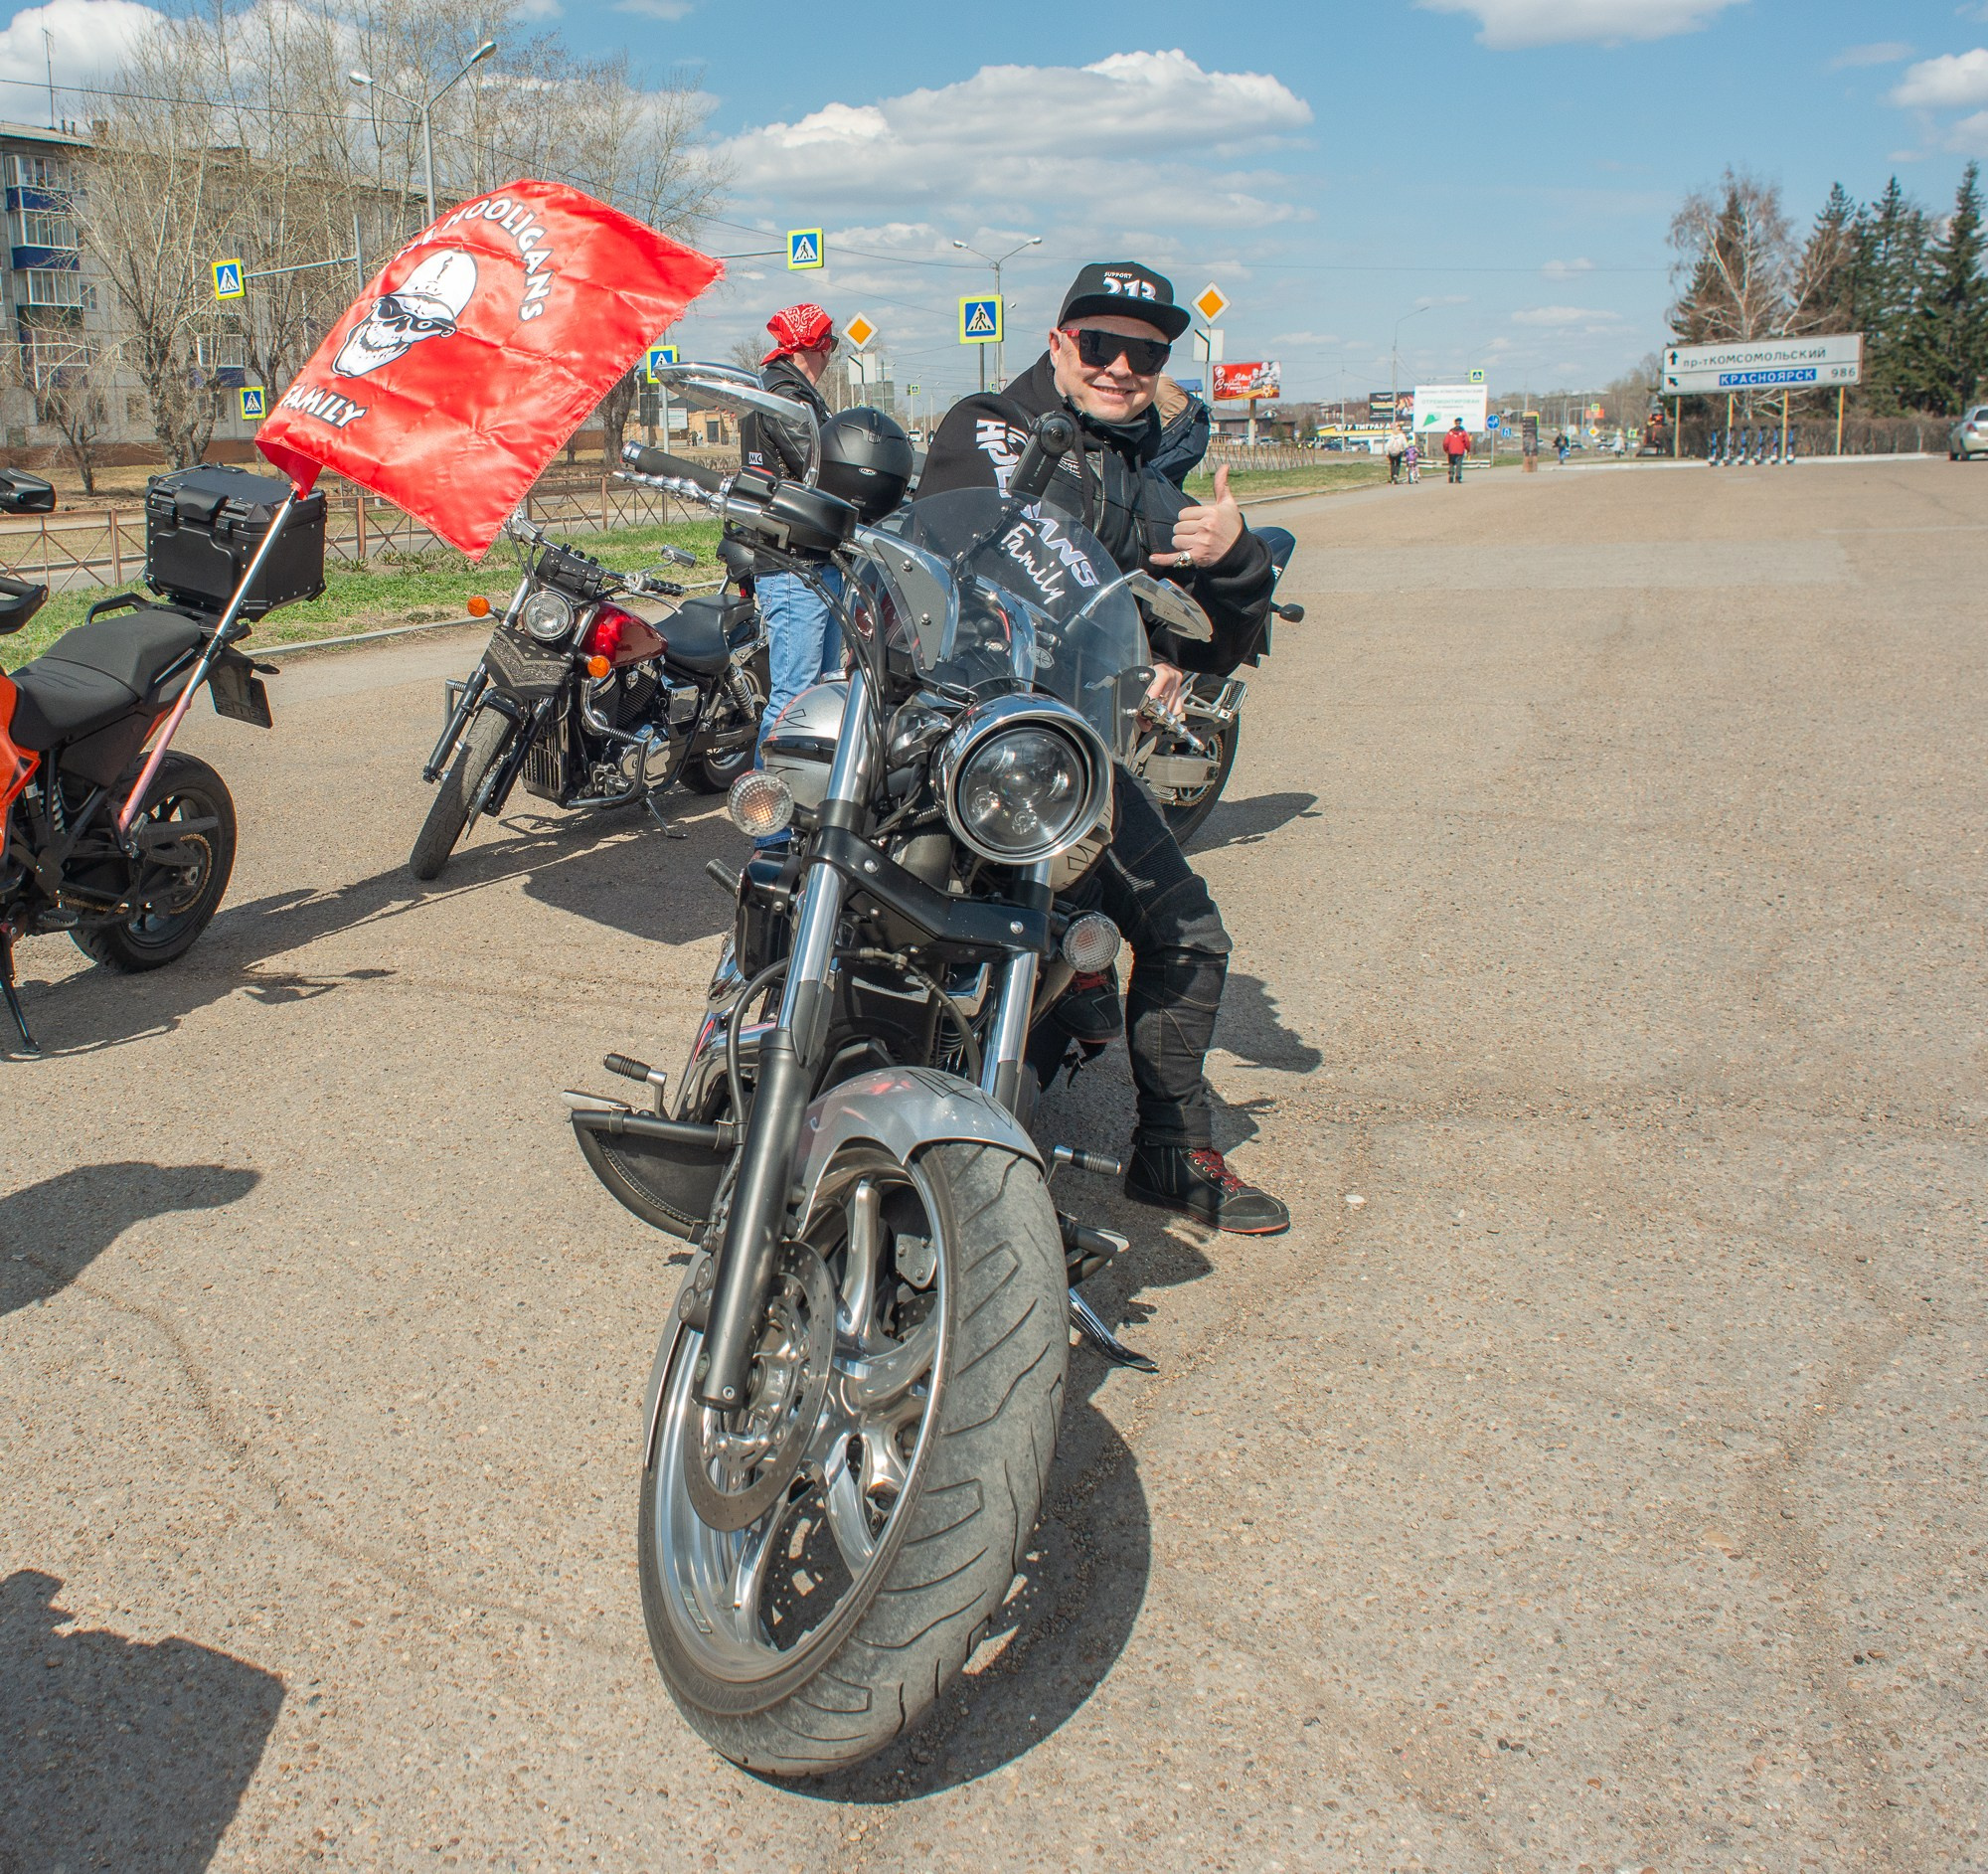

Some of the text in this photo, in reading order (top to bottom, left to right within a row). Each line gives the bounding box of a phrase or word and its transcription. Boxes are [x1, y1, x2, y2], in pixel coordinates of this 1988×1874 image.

[440, 197, 554, 321] HOOLIGANS
[1720, 368, 1856, 386] КРАСНОЯРСК 986
[278, 382, 369, 429] FAMILY
[748, 452, 762, 464] MC
[1000, 522, 1066, 604] Family
